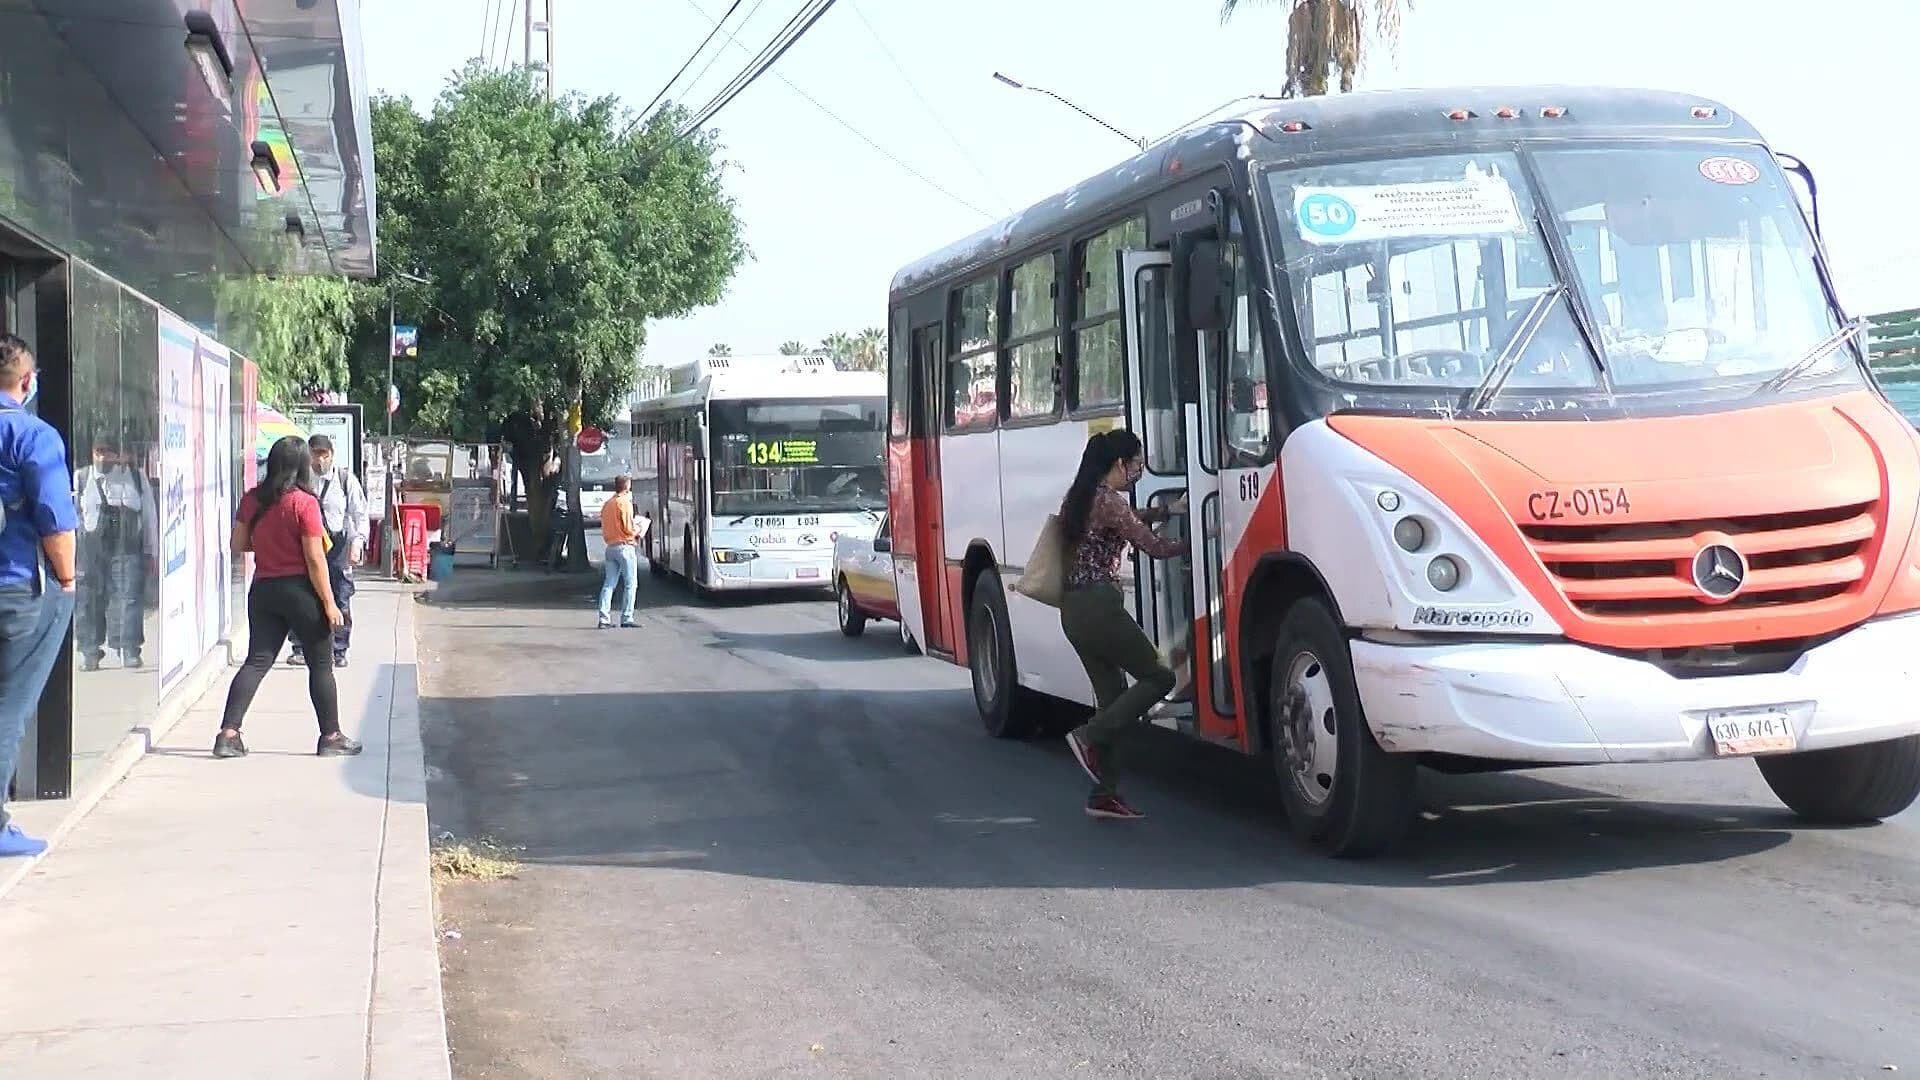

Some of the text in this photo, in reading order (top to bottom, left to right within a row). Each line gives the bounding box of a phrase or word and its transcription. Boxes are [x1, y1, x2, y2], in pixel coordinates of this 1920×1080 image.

[1308, 202, 1348, 224] 50
[747, 441, 781, 464] 134
[1240, 472, 1259, 501] 619
[1528, 488, 1630, 520] CZ-0154
[1412, 606, 1534, 628] Marcopolo
[1715, 717, 1788, 740] 630-674-T
